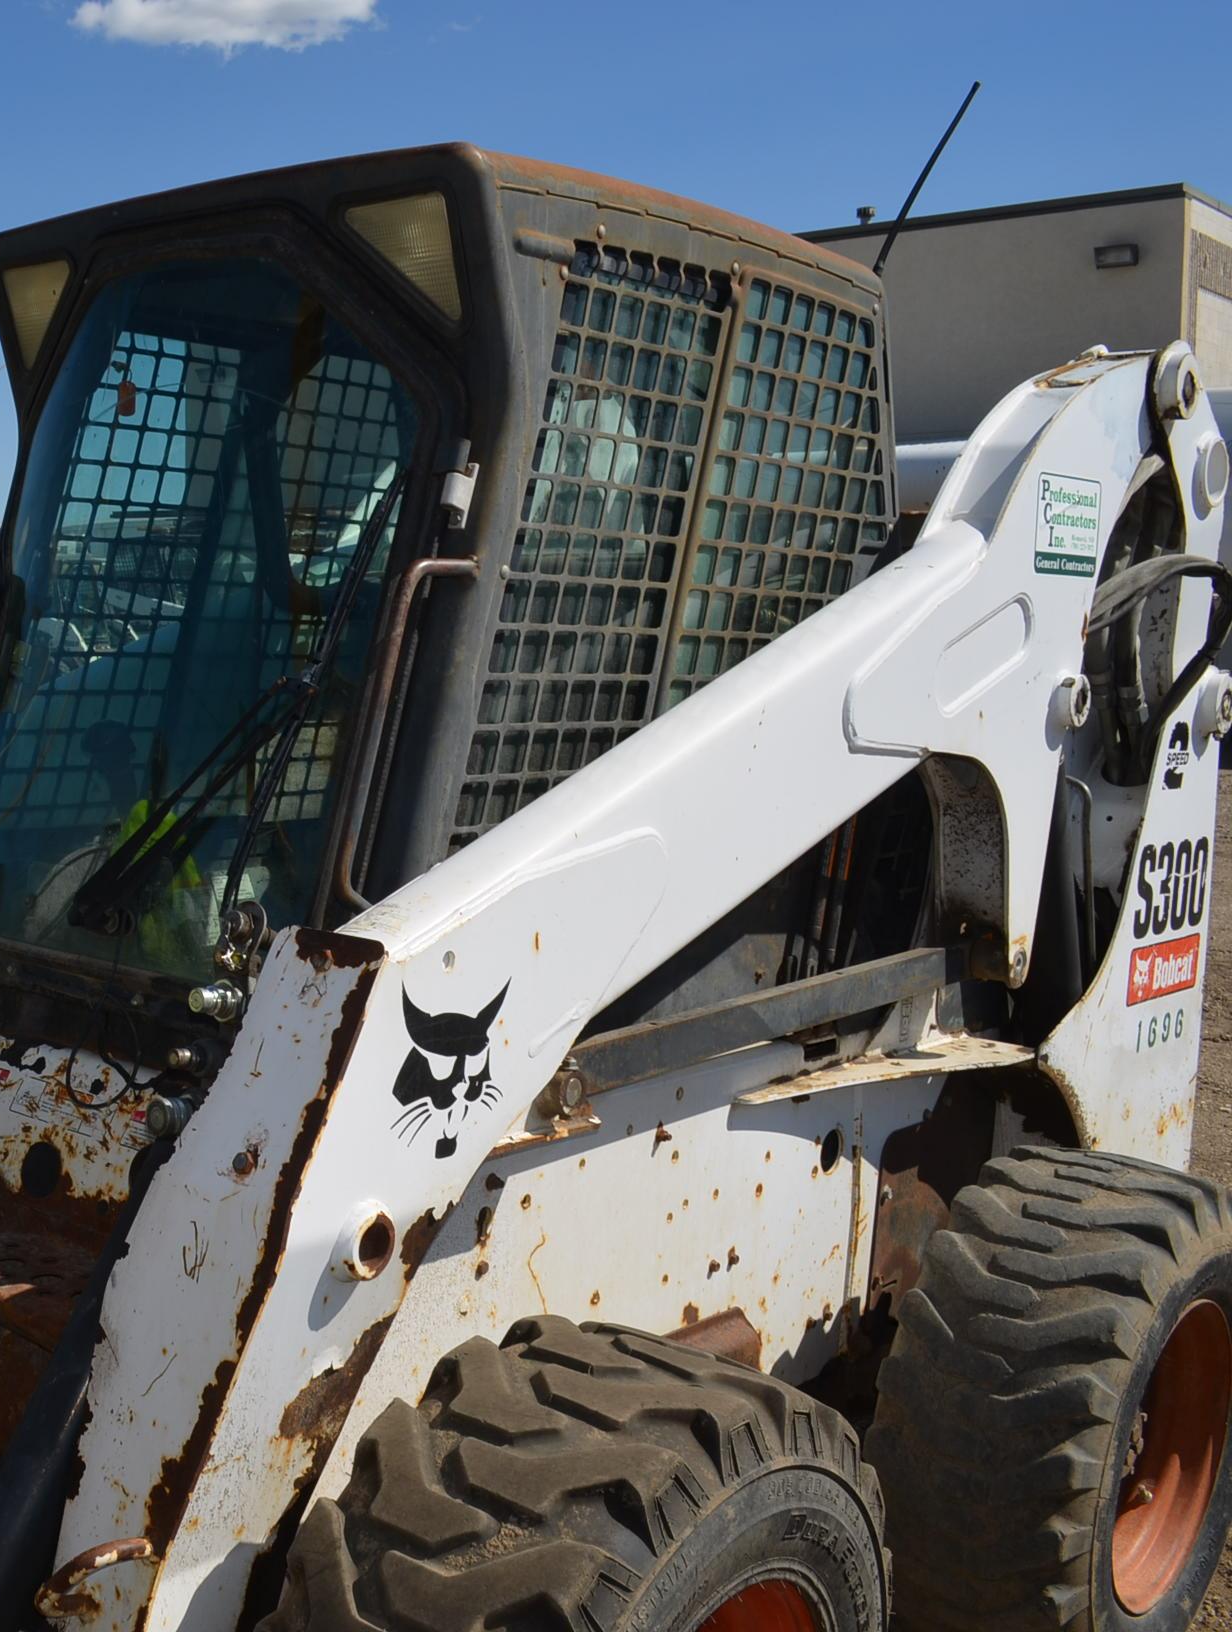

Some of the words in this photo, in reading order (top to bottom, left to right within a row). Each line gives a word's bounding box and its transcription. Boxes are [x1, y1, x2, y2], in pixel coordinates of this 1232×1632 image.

[1041, 479, 1097, 508] Professional
[1043, 502, 1097, 530] Contractors
[1048, 526, 1067, 548] Inc.
[1035, 556, 1060, 571] General
[1060, 558, 1095, 574] Contractors
[1166, 752, 1190, 766] SPEED
[1133, 836, 1209, 939] S300
[1152, 949, 1194, 991] Bobcat
[1135, 1008, 1184, 1053] 1696
